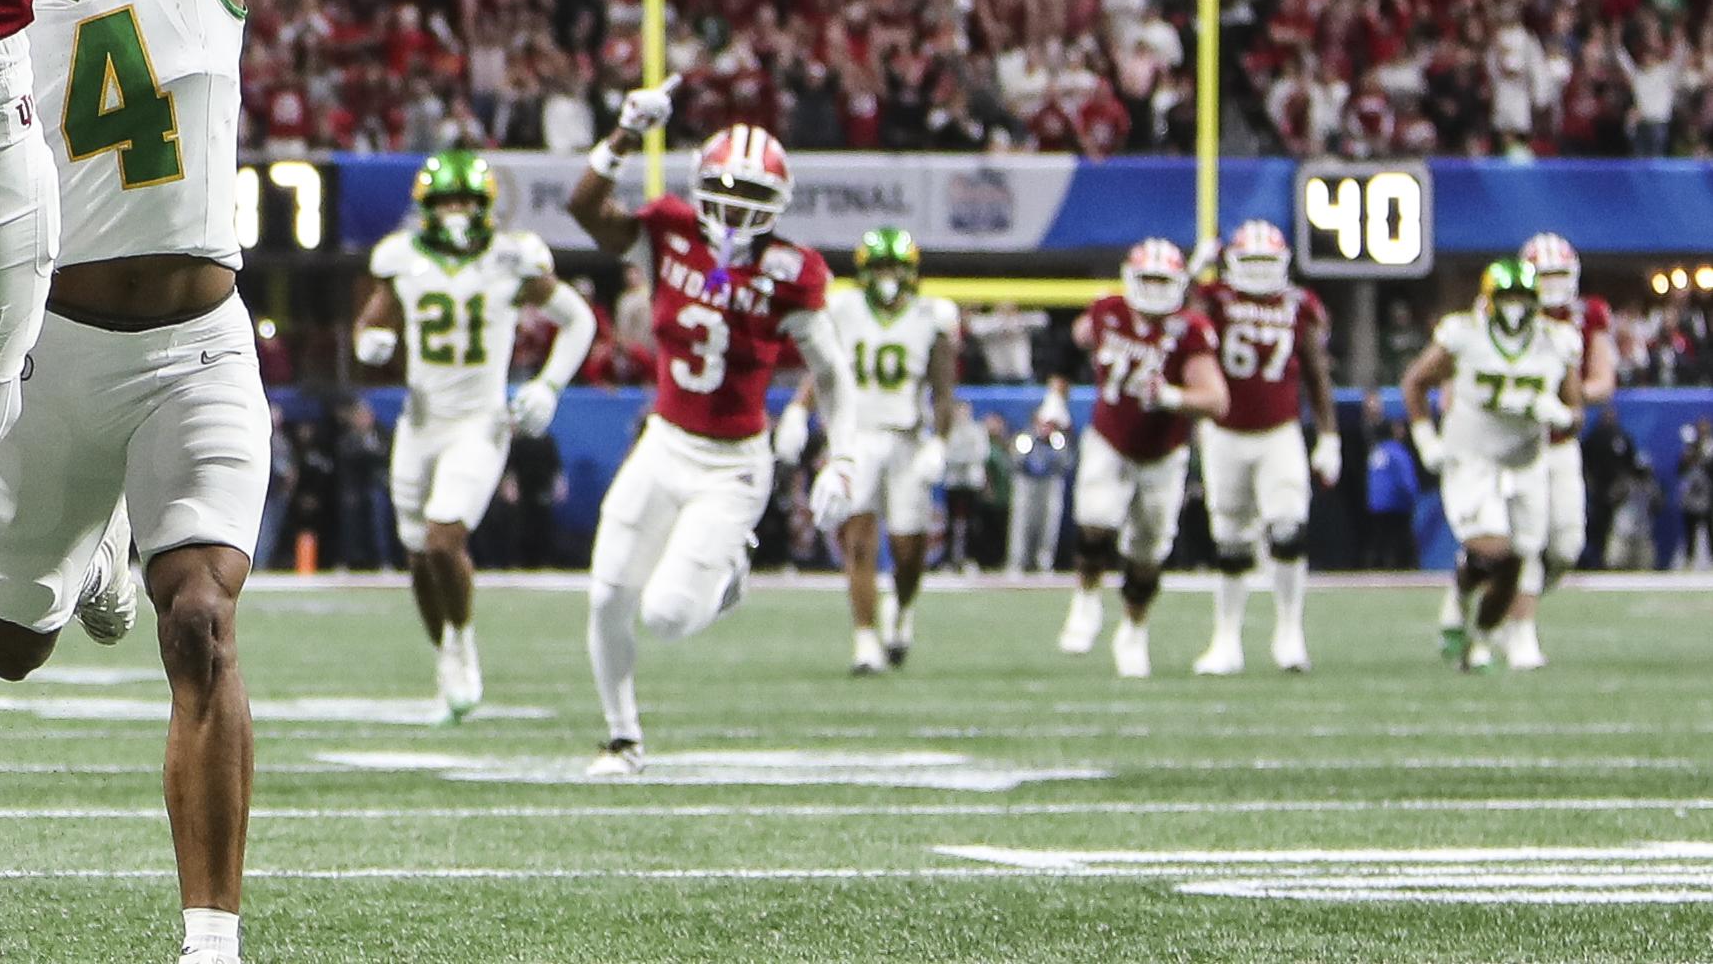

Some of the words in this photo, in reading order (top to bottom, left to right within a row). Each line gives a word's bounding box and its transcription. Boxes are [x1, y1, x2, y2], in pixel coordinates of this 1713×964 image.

[59, 3, 185, 191] 4
[1305, 172, 1423, 266] 40
[416, 291, 487, 366] 21
[669, 302, 731, 394] 3
[853, 339, 908, 390] 10
[1222, 323, 1295, 383] 67
